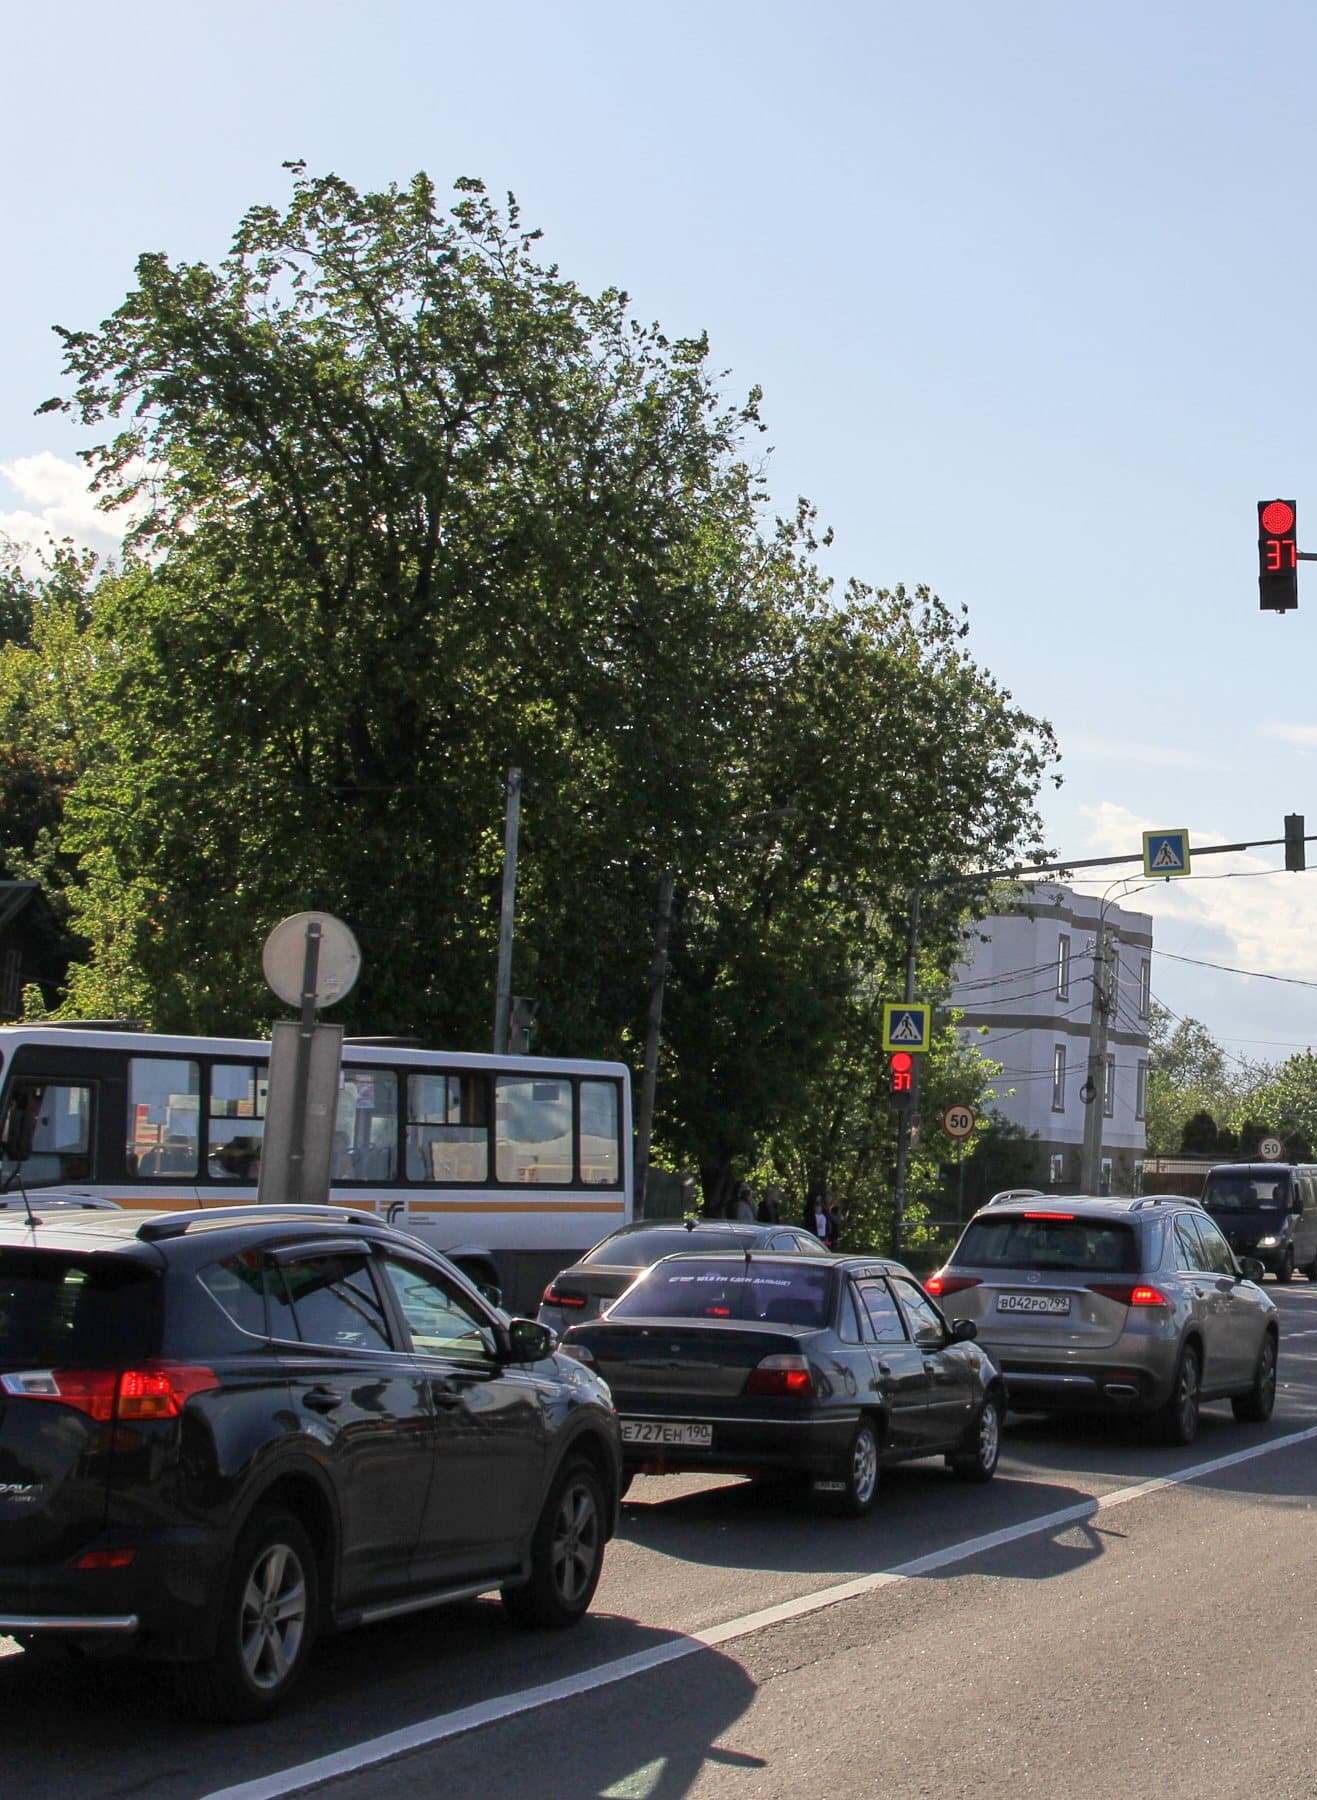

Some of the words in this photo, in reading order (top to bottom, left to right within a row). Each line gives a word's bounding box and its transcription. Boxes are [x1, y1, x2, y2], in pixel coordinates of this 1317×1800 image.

[1266, 540, 1296, 570] 37
[893, 1073, 912, 1091] 37
[950, 1114, 968, 1128] 50
[1264, 1143, 1278, 1154] 50
